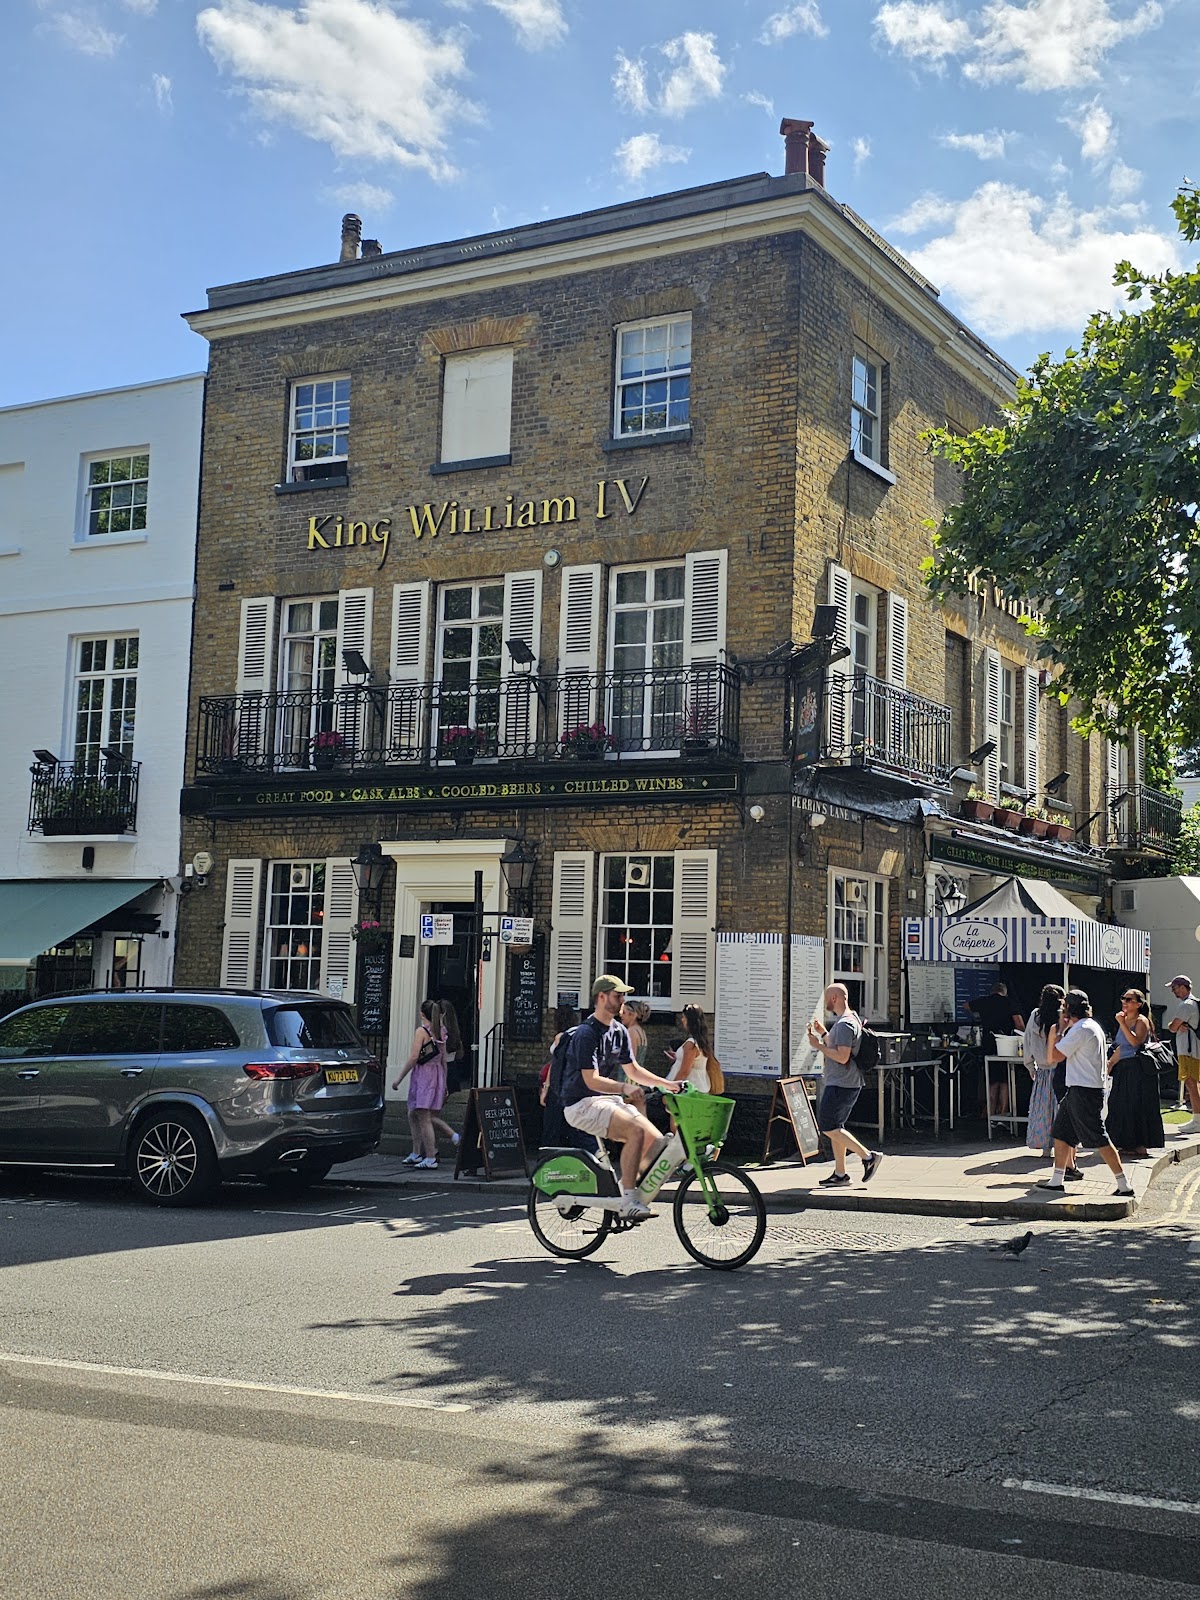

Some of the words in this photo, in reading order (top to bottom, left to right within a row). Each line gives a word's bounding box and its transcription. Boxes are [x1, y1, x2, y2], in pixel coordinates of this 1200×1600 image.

[307, 515, 391, 570] King
[596, 476, 649, 520] IV
[256, 792, 295, 804] GREAT
[300, 790, 334, 802] FOOD
[352, 789, 384, 801] CASK
[388, 787, 419, 799] ALES
[441, 784, 497, 797] COOLED
[501, 782, 541, 795] BEERS
[564, 779, 630, 793] CHILLED
[635, 777, 684, 791] WINES
[792, 795, 828, 815] PERRIN'S
[830, 804, 849, 820] LANE
[966, 924, 980, 937] La
